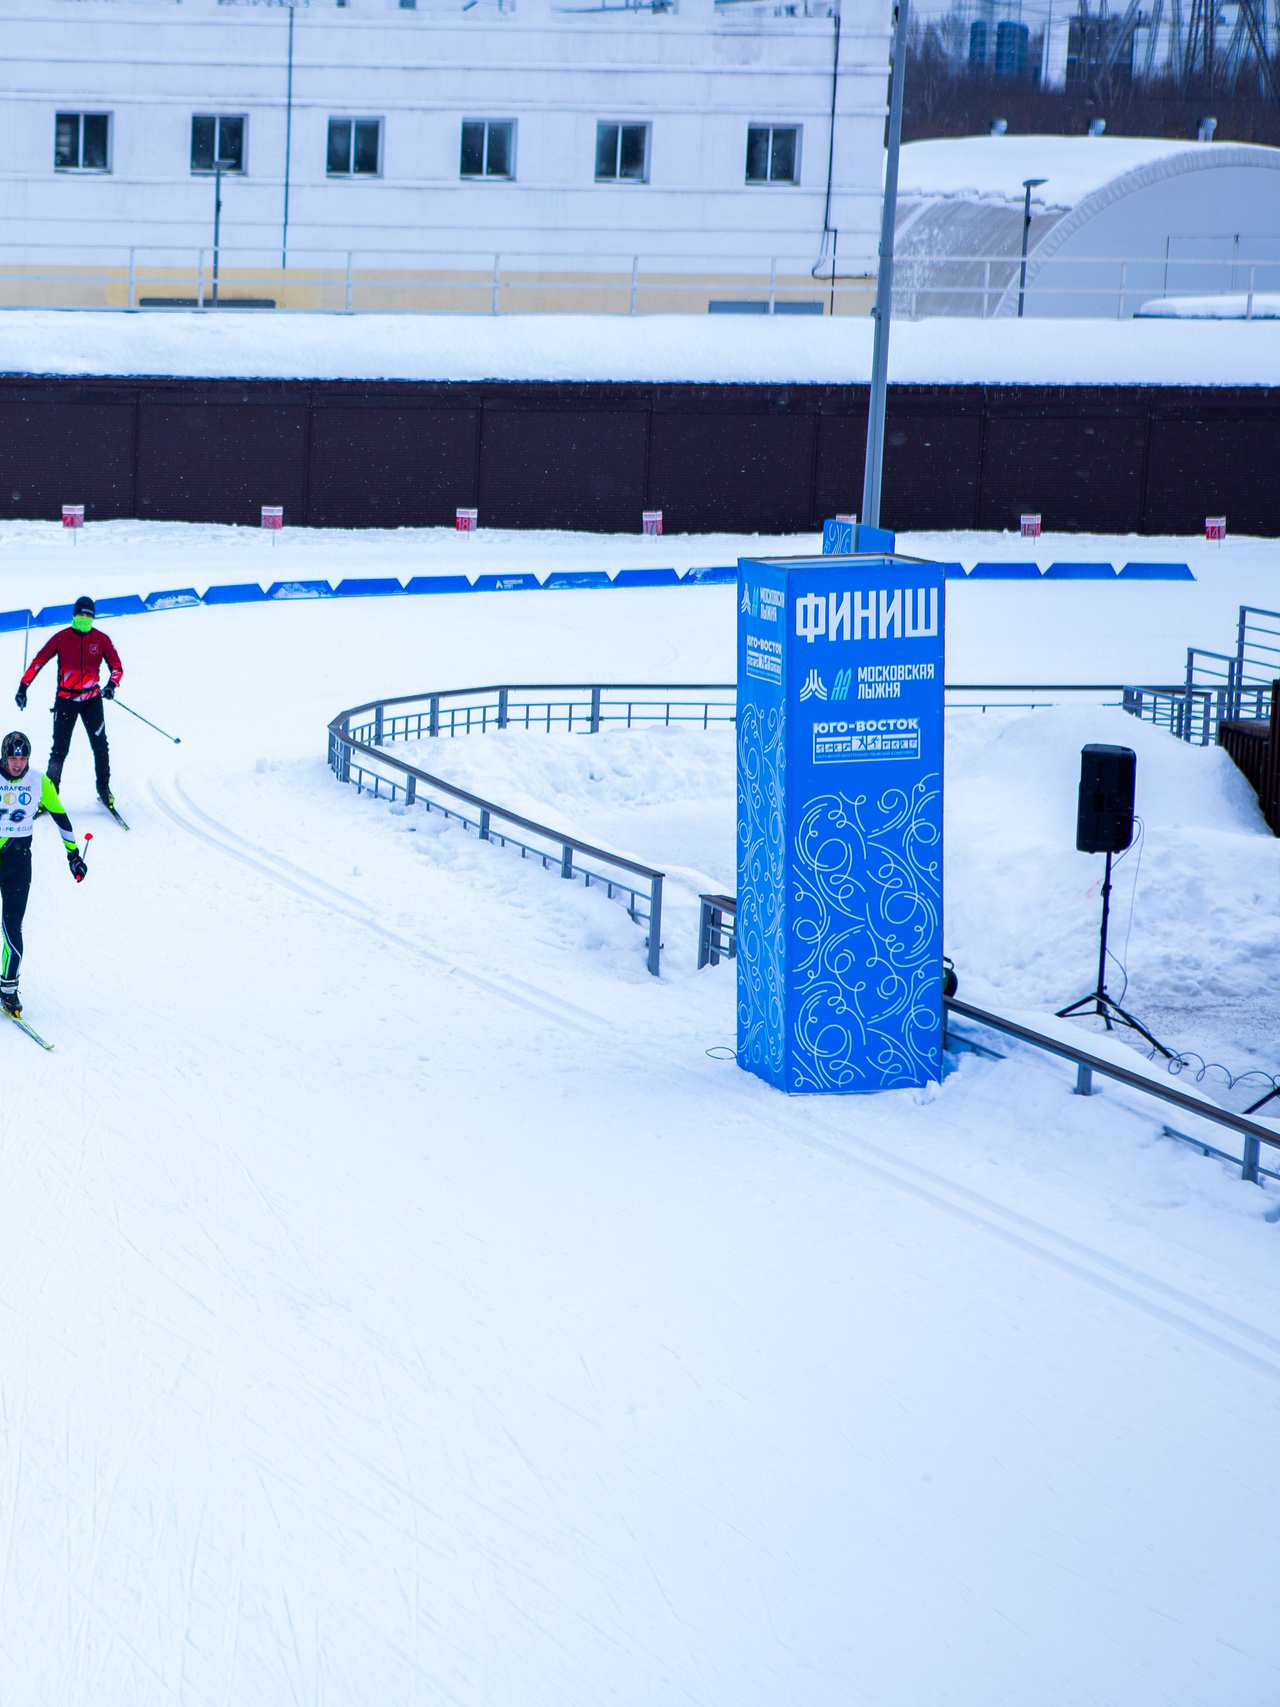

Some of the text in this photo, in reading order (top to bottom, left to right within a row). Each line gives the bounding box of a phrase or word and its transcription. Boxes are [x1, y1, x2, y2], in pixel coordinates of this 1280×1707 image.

[643, 521, 656, 534] 17
[1021, 524, 1035, 537] 15
[1206, 527, 1220, 539] 14
[795, 587, 938, 643] ФИНИШ
[858, 663, 935, 683] МОСКОВСКАЯ
[857, 682, 901, 700] ЛЫЖНЯ
[814, 718, 919, 734] ЮГО-ВОСТОК
